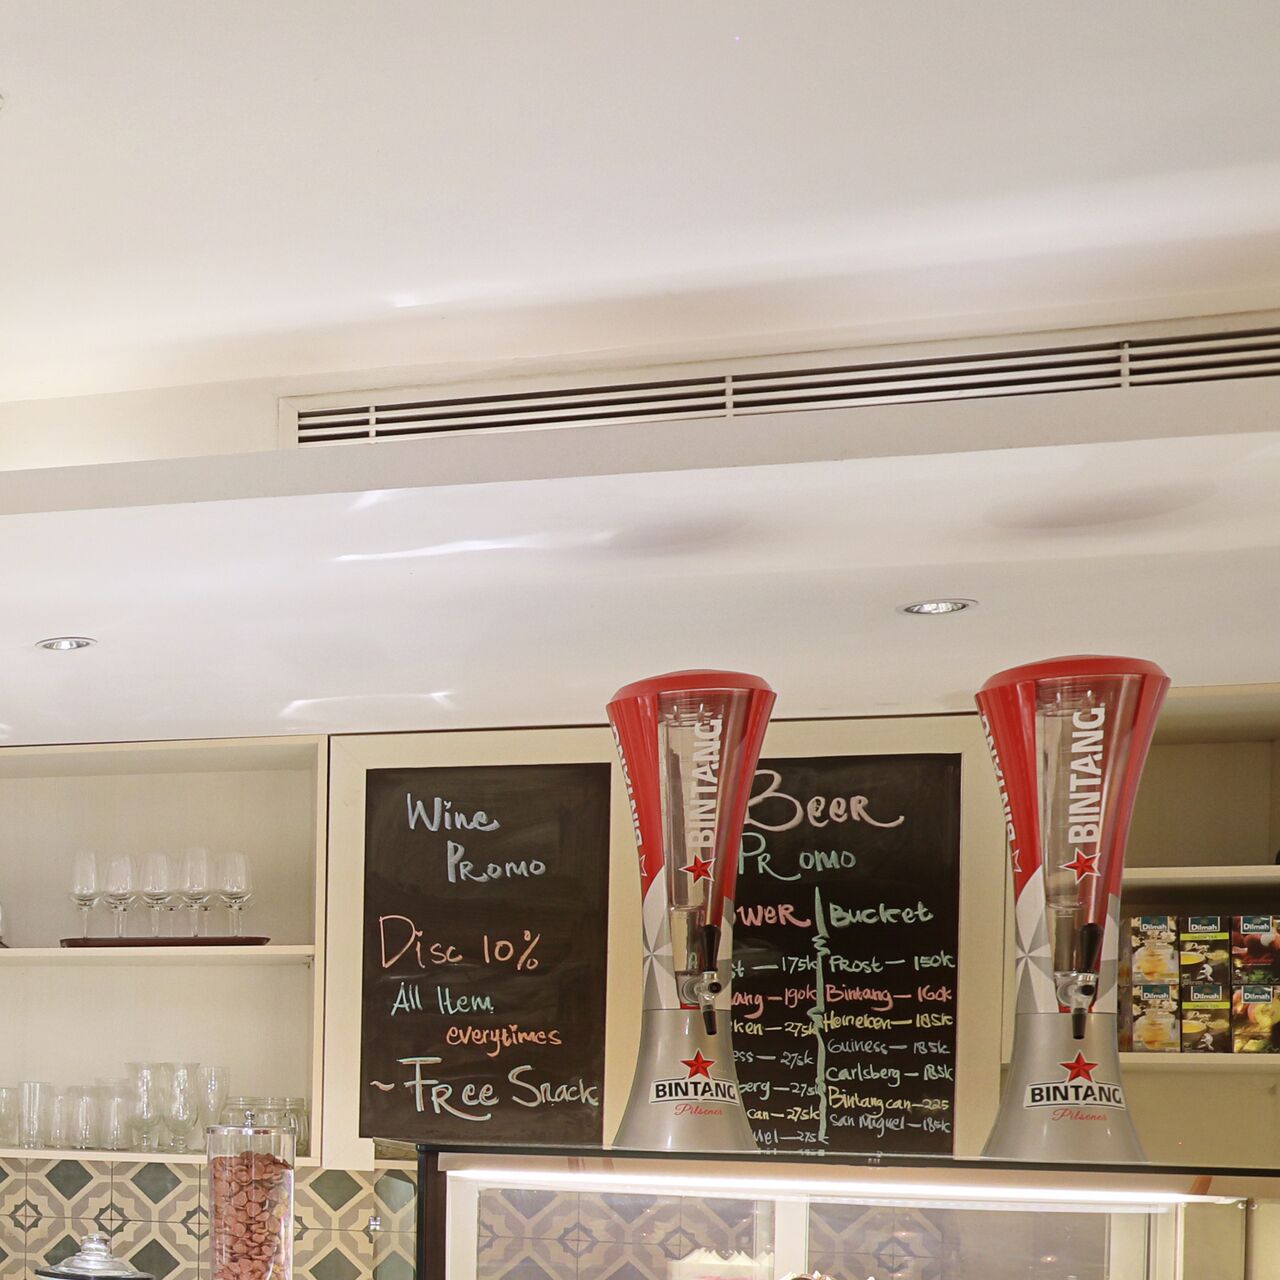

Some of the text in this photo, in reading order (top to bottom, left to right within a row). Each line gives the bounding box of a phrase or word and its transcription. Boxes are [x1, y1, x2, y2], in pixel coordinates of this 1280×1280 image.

[688, 719, 723, 848] BINTANG
[1068, 706, 1105, 844] BINTANG
[406, 793, 501, 832] Wine
[829, 901, 935, 928] Bucket
[1191, 923, 1218, 931] Dilmah
[379, 915, 541, 971] Disc 10%
[391, 982, 423, 1016] All
[825, 984, 894, 1012] Bintang
[446, 1024, 563, 1058] everytimes
[507, 1065, 600, 1108] Snack
[655, 1082, 736, 1100] BINTANG
[826, 1062, 901, 1088] Carlsberg
[1031, 1085, 1123, 1104] BINTANG
